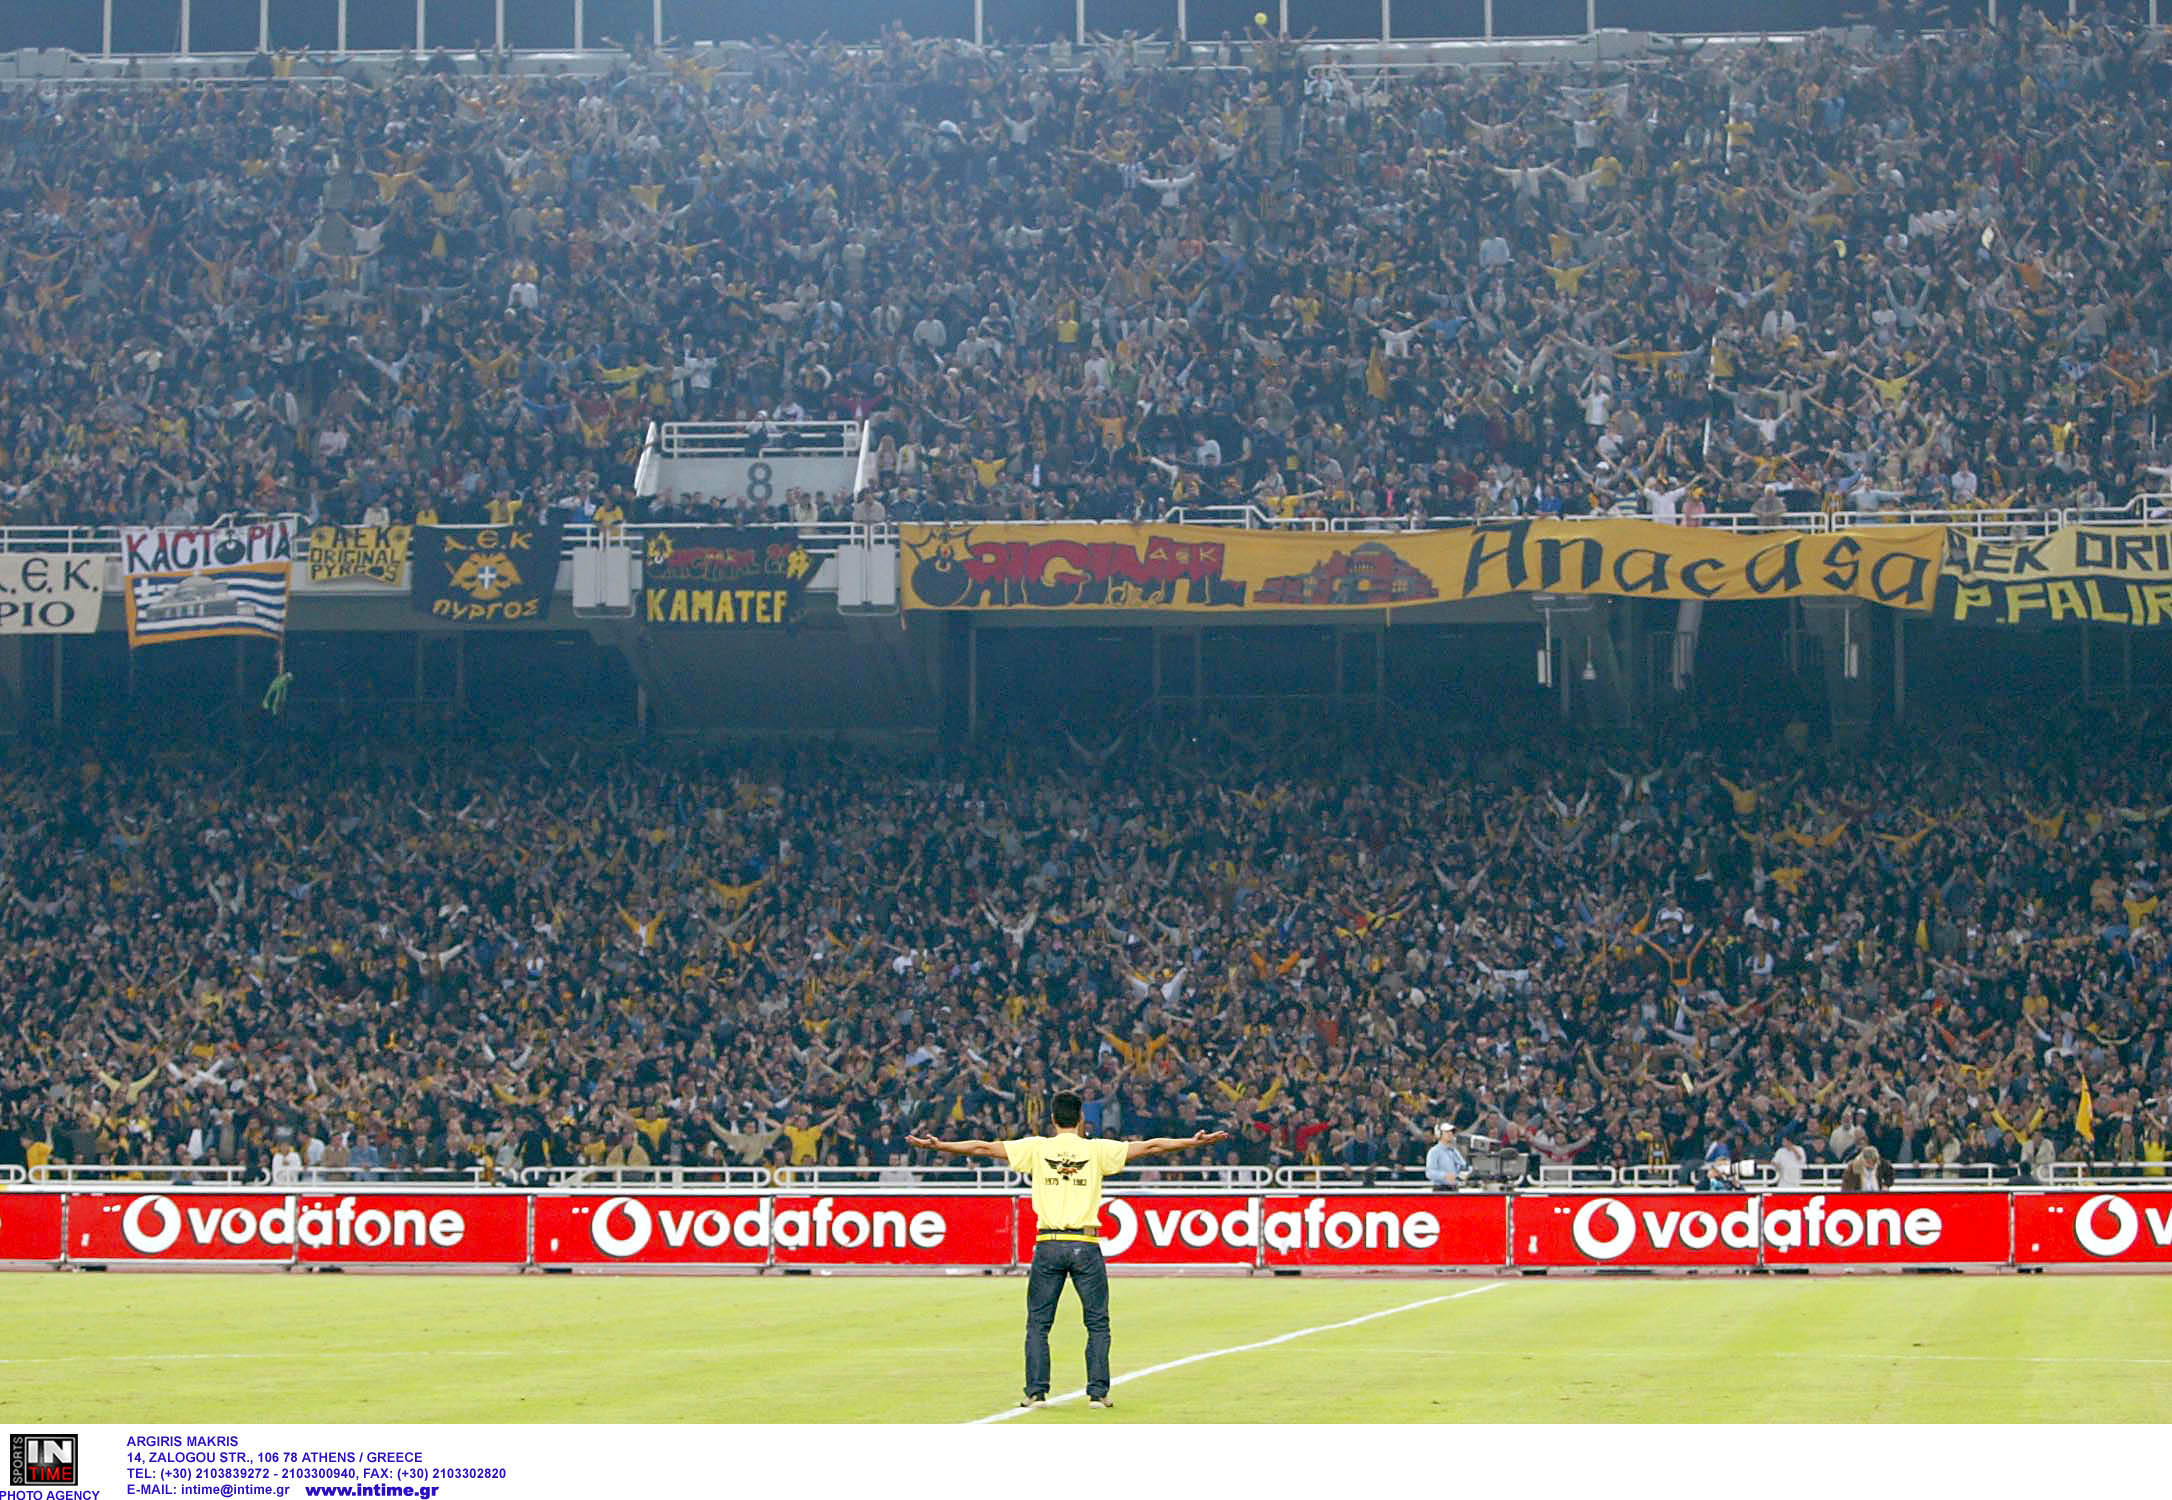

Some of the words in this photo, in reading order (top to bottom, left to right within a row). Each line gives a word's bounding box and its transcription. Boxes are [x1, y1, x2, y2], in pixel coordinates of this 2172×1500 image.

[747, 463, 773, 503] 8
[310, 547, 401, 565] ORIGINAL
[187, 1197, 466, 1248] vodafone
[658, 1197, 947, 1250] vodafone
[1144, 1197, 1440, 1252] vodafone
[1642, 1196, 1943, 1250] vodafone
